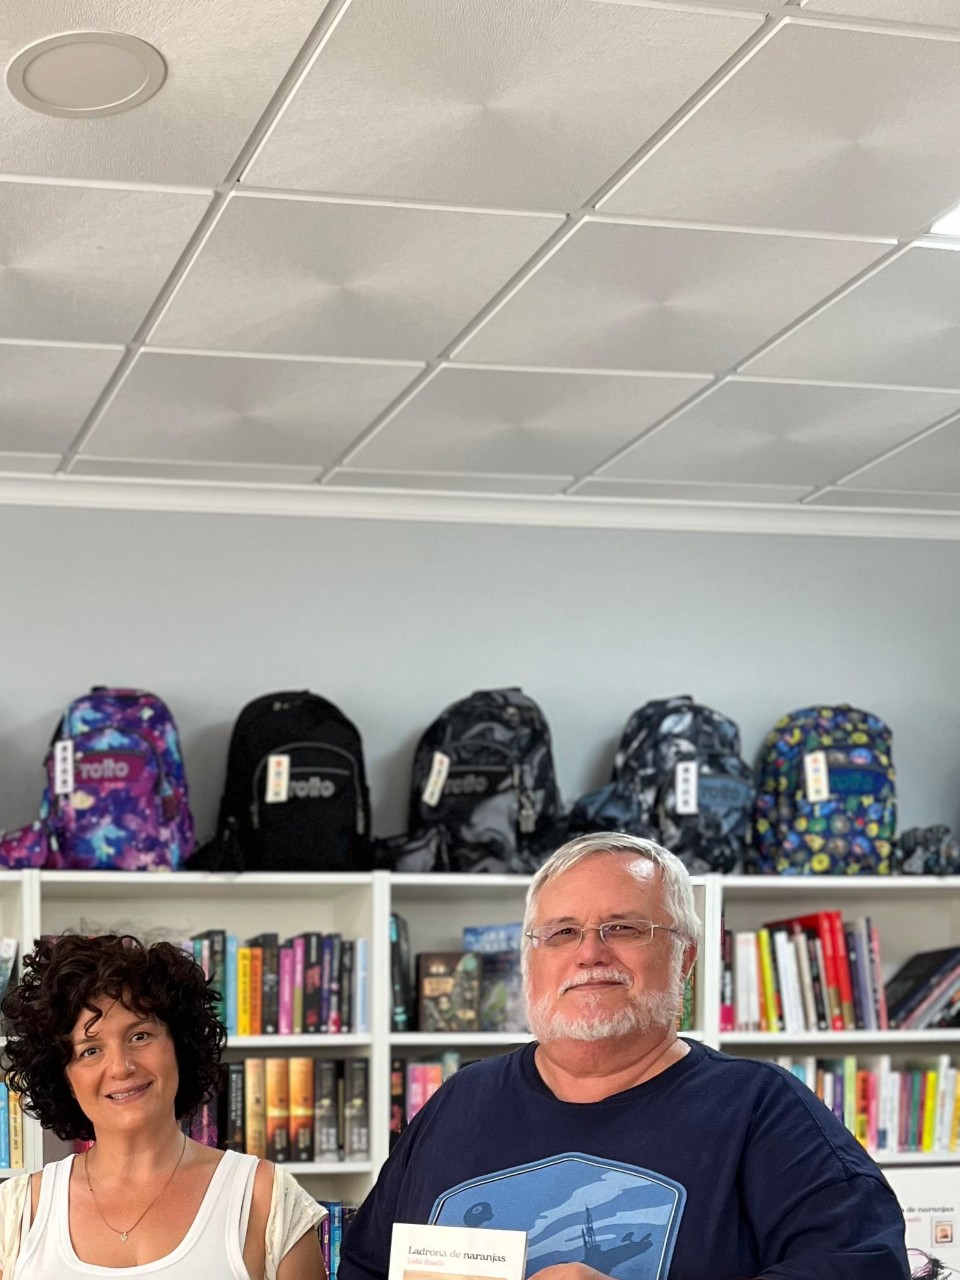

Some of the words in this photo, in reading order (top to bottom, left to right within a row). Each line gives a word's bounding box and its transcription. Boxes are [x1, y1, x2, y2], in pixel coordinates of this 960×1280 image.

[408, 1245, 447, 1258] Ladrona
[449, 1249, 461, 1259] de
[463, 1251, 506, 1263] naranjas
